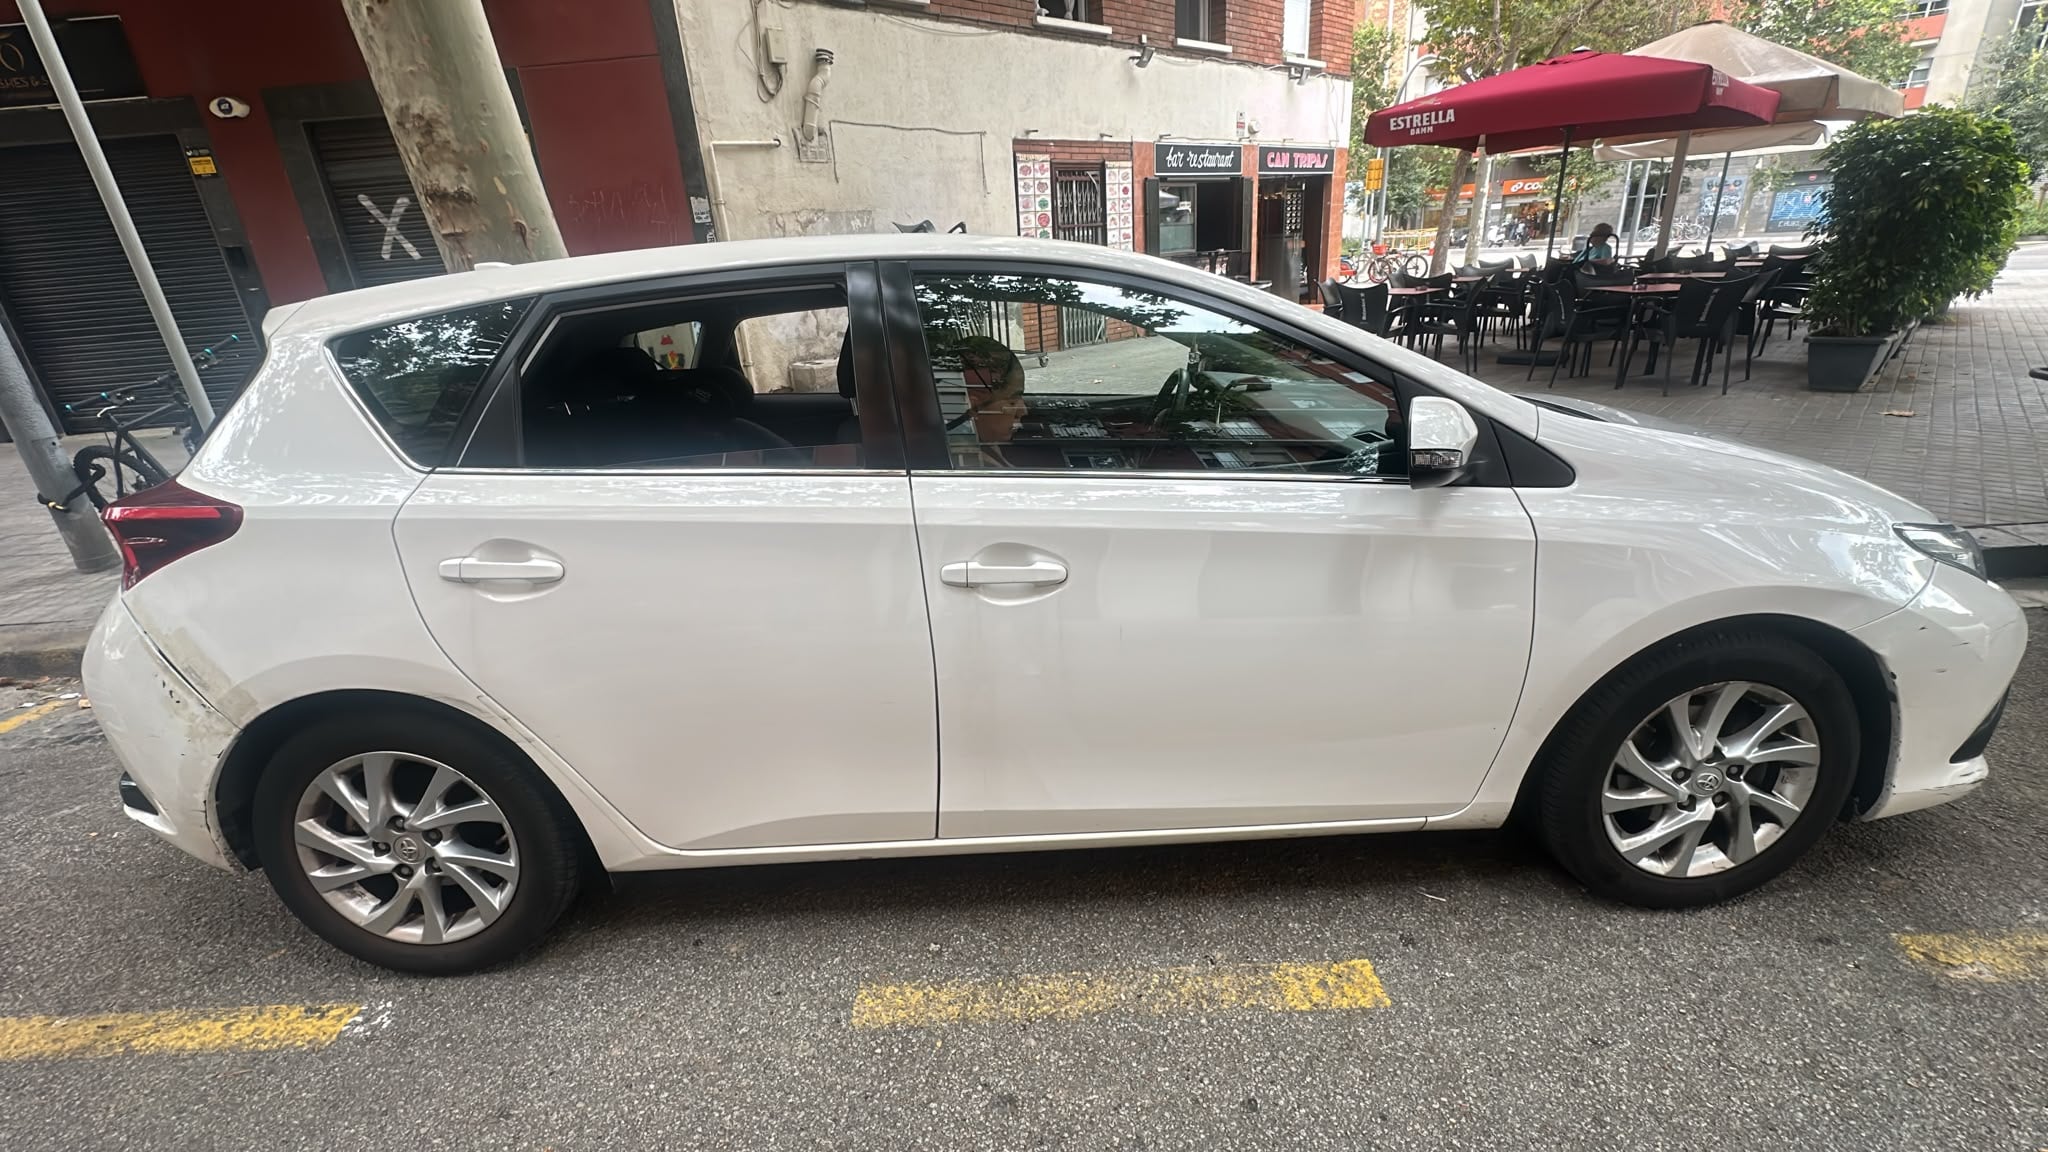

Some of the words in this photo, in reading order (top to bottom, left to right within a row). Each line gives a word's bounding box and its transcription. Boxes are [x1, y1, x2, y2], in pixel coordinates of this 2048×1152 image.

[1390, 109, 1455, 131] ESTRELLA
[1410, 126, 1433, 136] DAMM
[1166, 146, 1184, 168] bar
[1187, 149, 1235, 168] restaurant
[1267, 151, 1290, 168] CAN
[1293, 152, 1328, 168] TRIPAS
